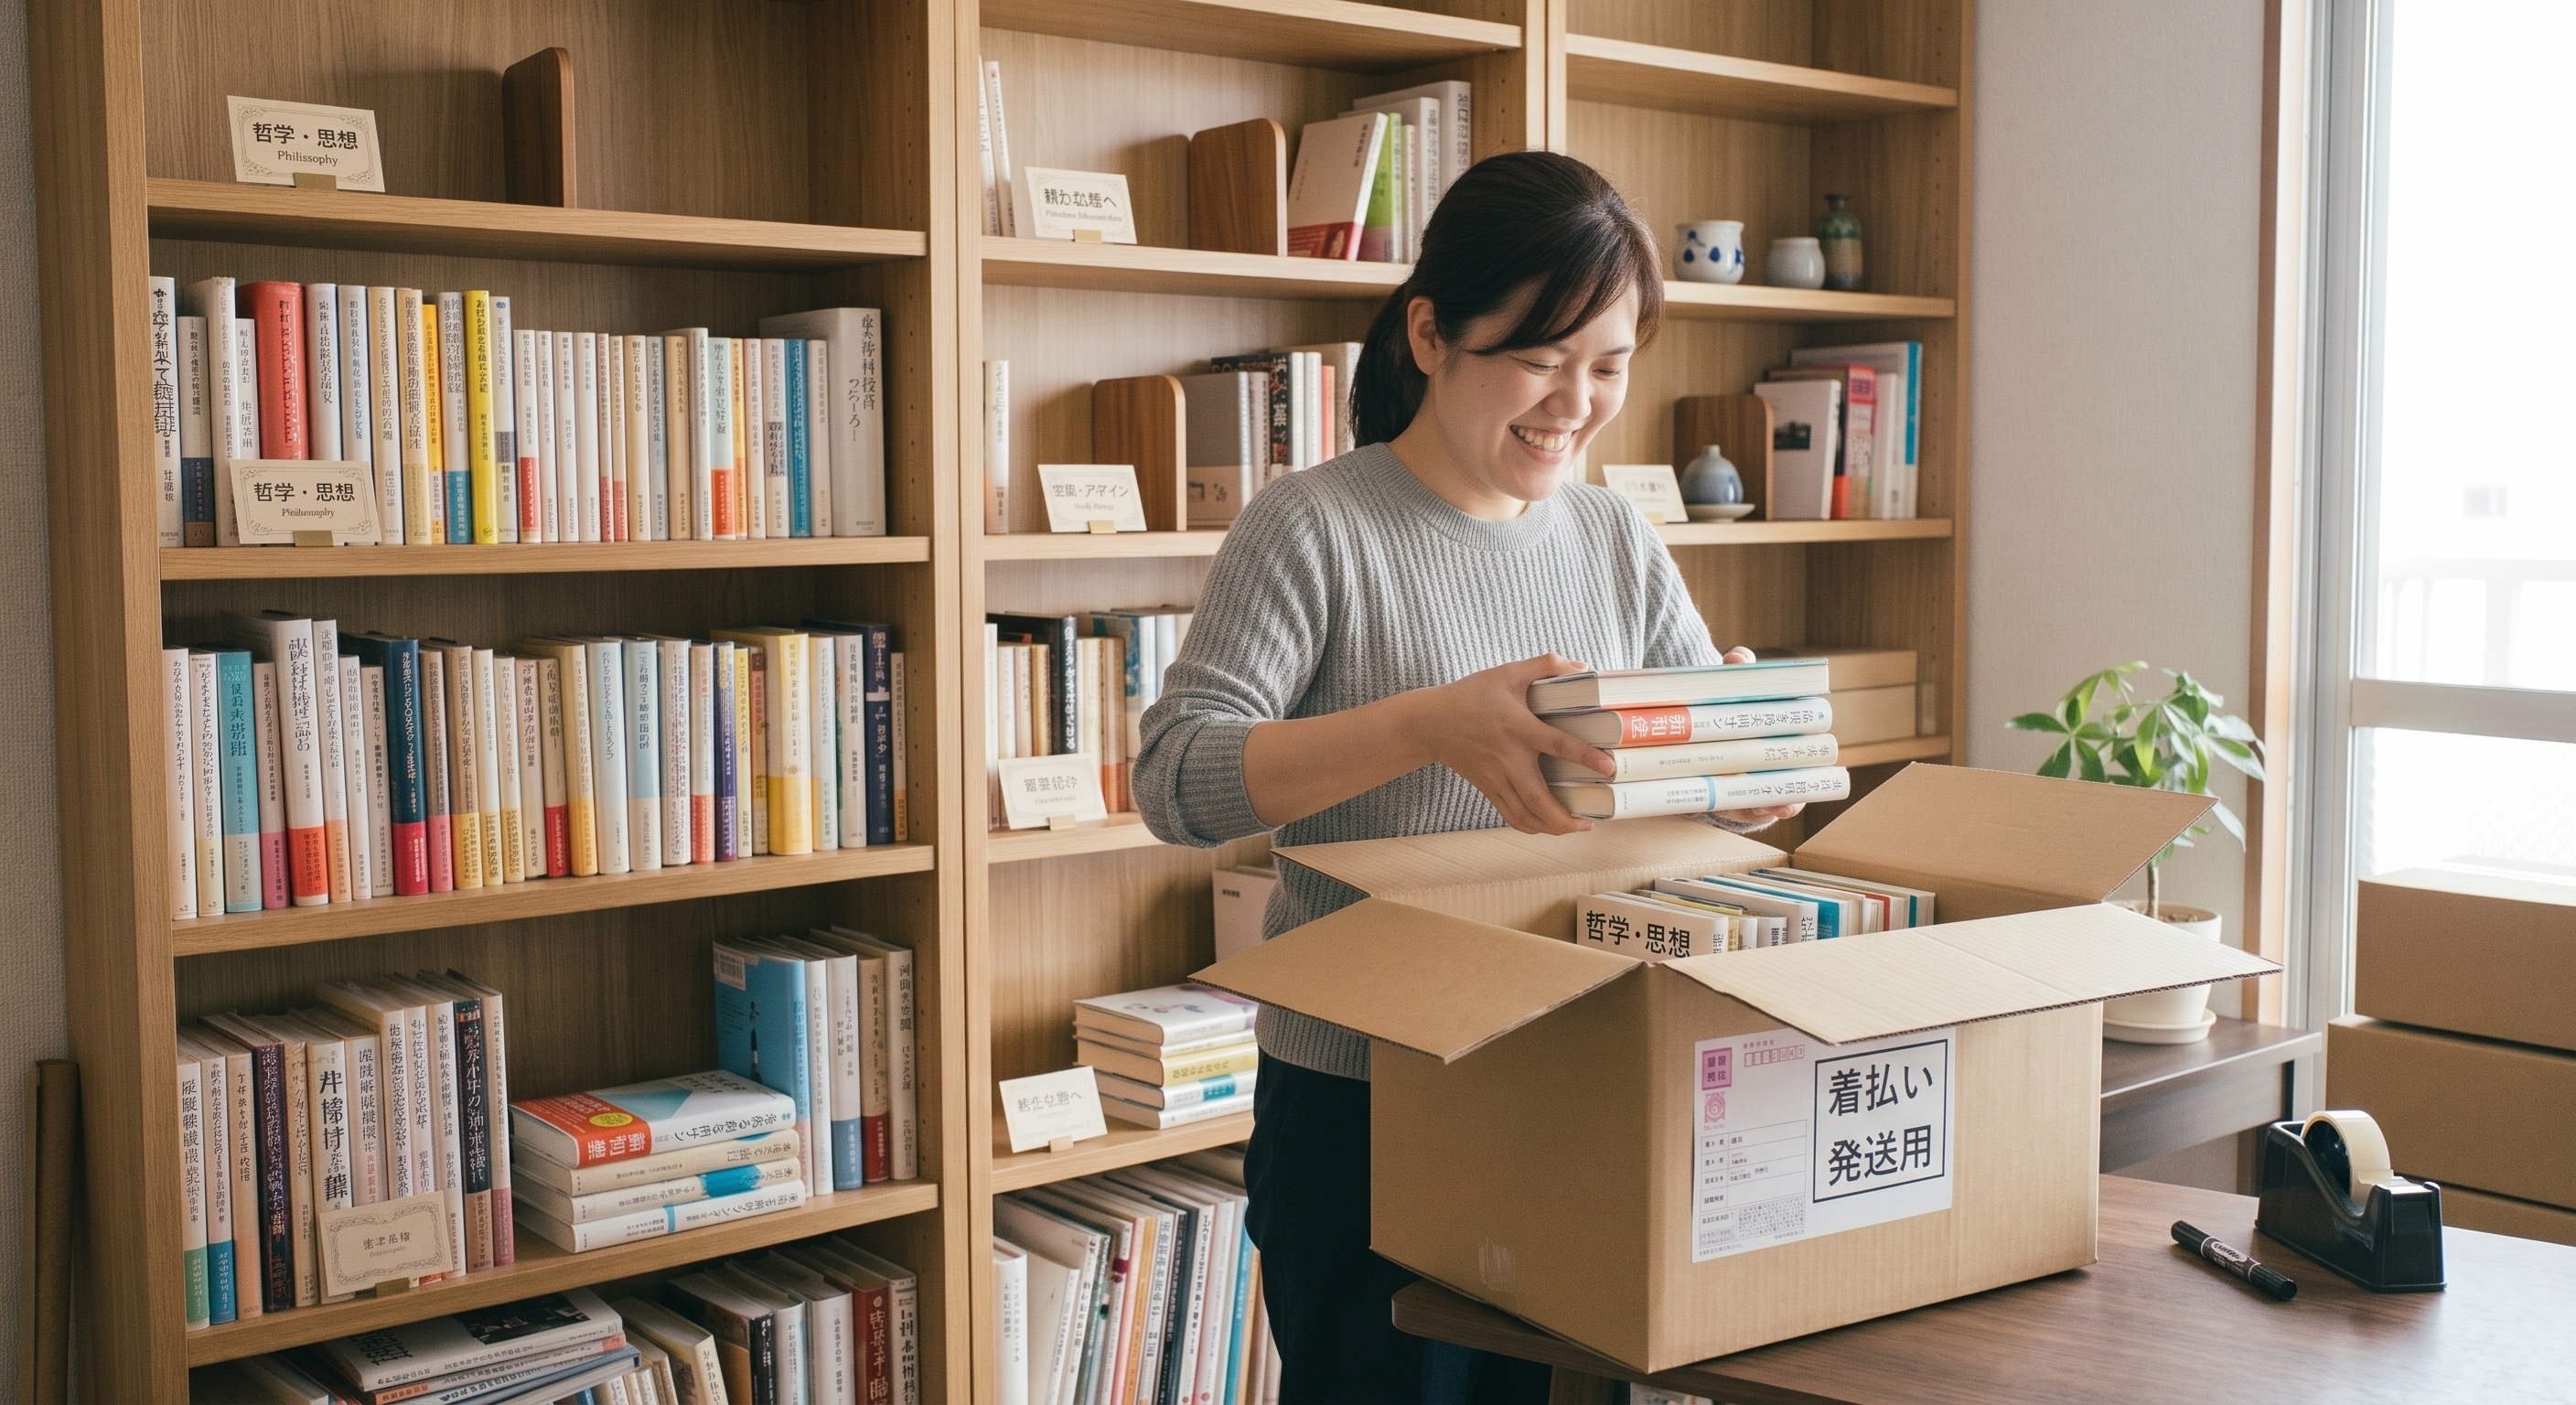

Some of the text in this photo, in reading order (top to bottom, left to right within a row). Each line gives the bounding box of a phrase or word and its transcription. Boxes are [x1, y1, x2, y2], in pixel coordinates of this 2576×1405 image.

[252, 122, 359, 150] 哲学・思想
[277, 150, 338, 166] Philissophy
[253, 482, 355, 502] 哲学・思想
[1586, 910, 1690, 958] 哲学・思想
[1828, 1063, 1934, 1117] 着払い
[1828, 1124, 1932, 1186] 発送用
